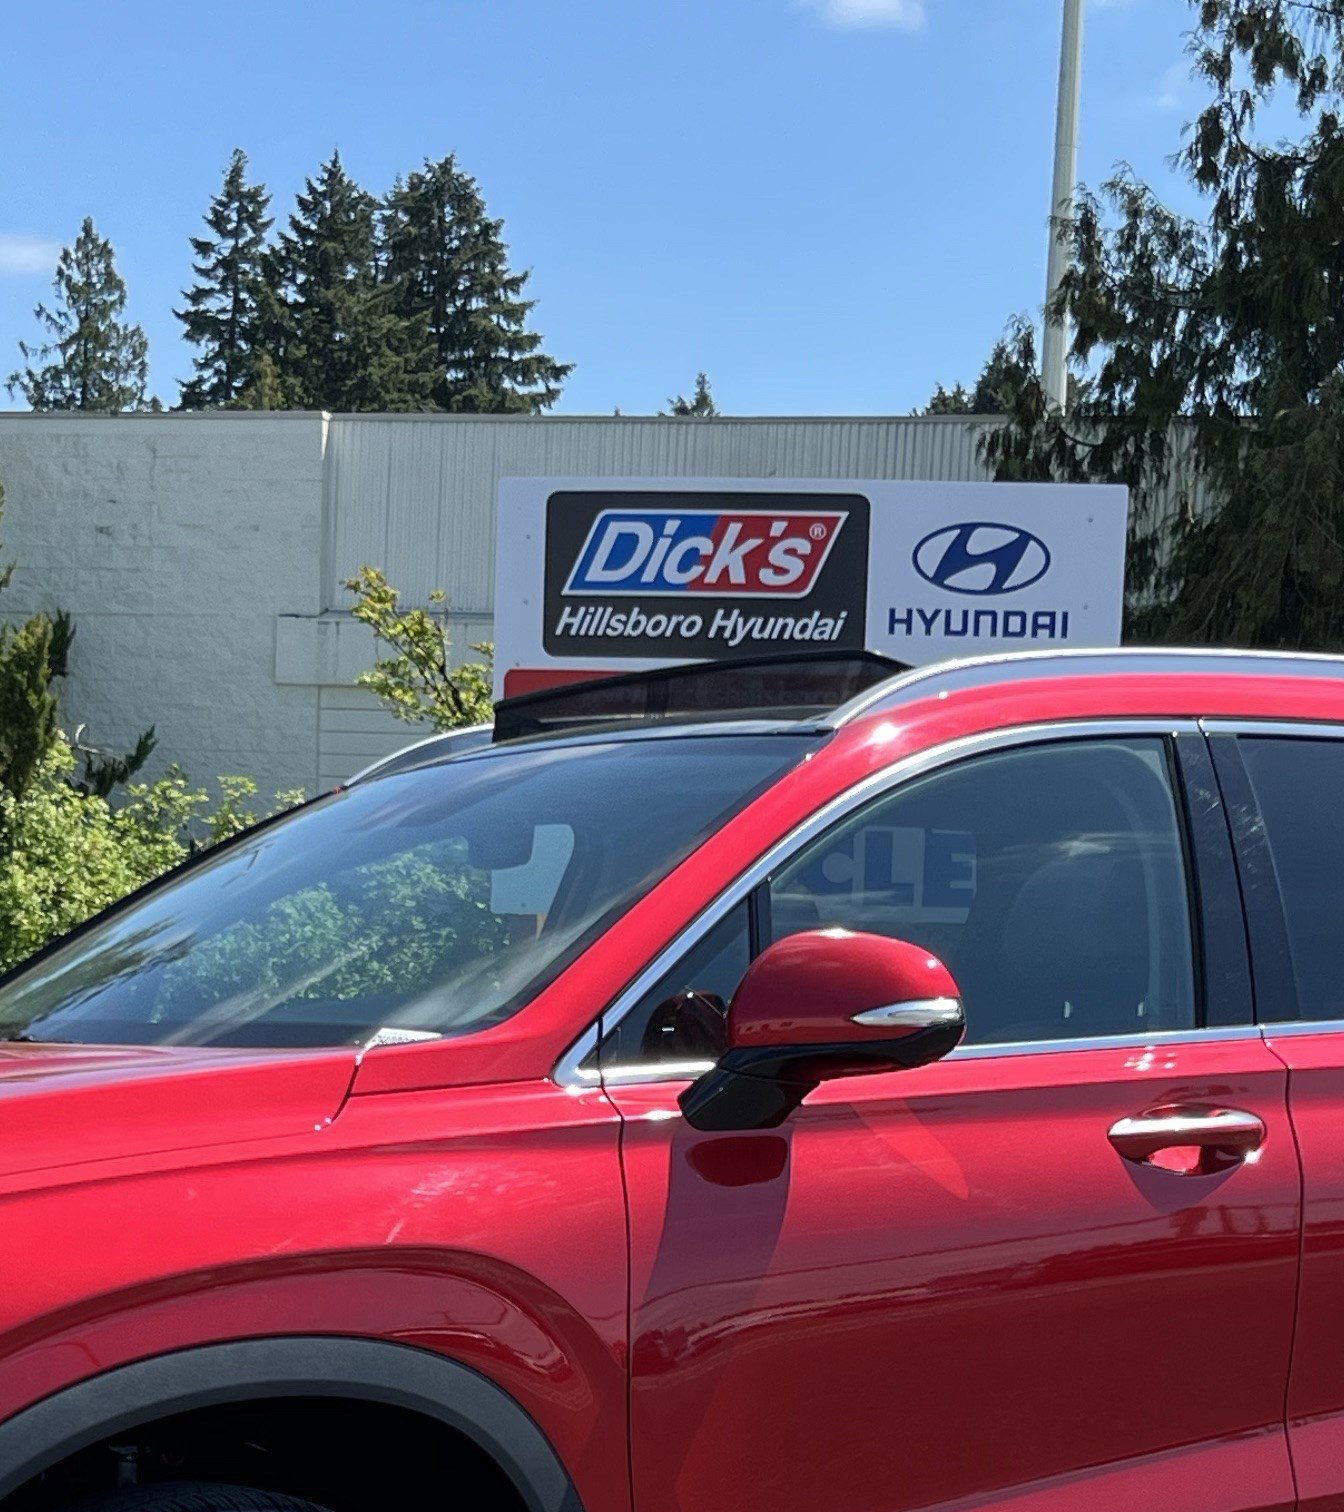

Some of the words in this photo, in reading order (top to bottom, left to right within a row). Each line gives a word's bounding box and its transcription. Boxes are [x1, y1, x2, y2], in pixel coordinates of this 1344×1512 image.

[584, 519, 811, 586] Dick's
[555, 606, 703, 638] Hillsboro
[707, 609, 847, 647] Hyundai
[887, 606, 1069, 639] HYUNDAI
